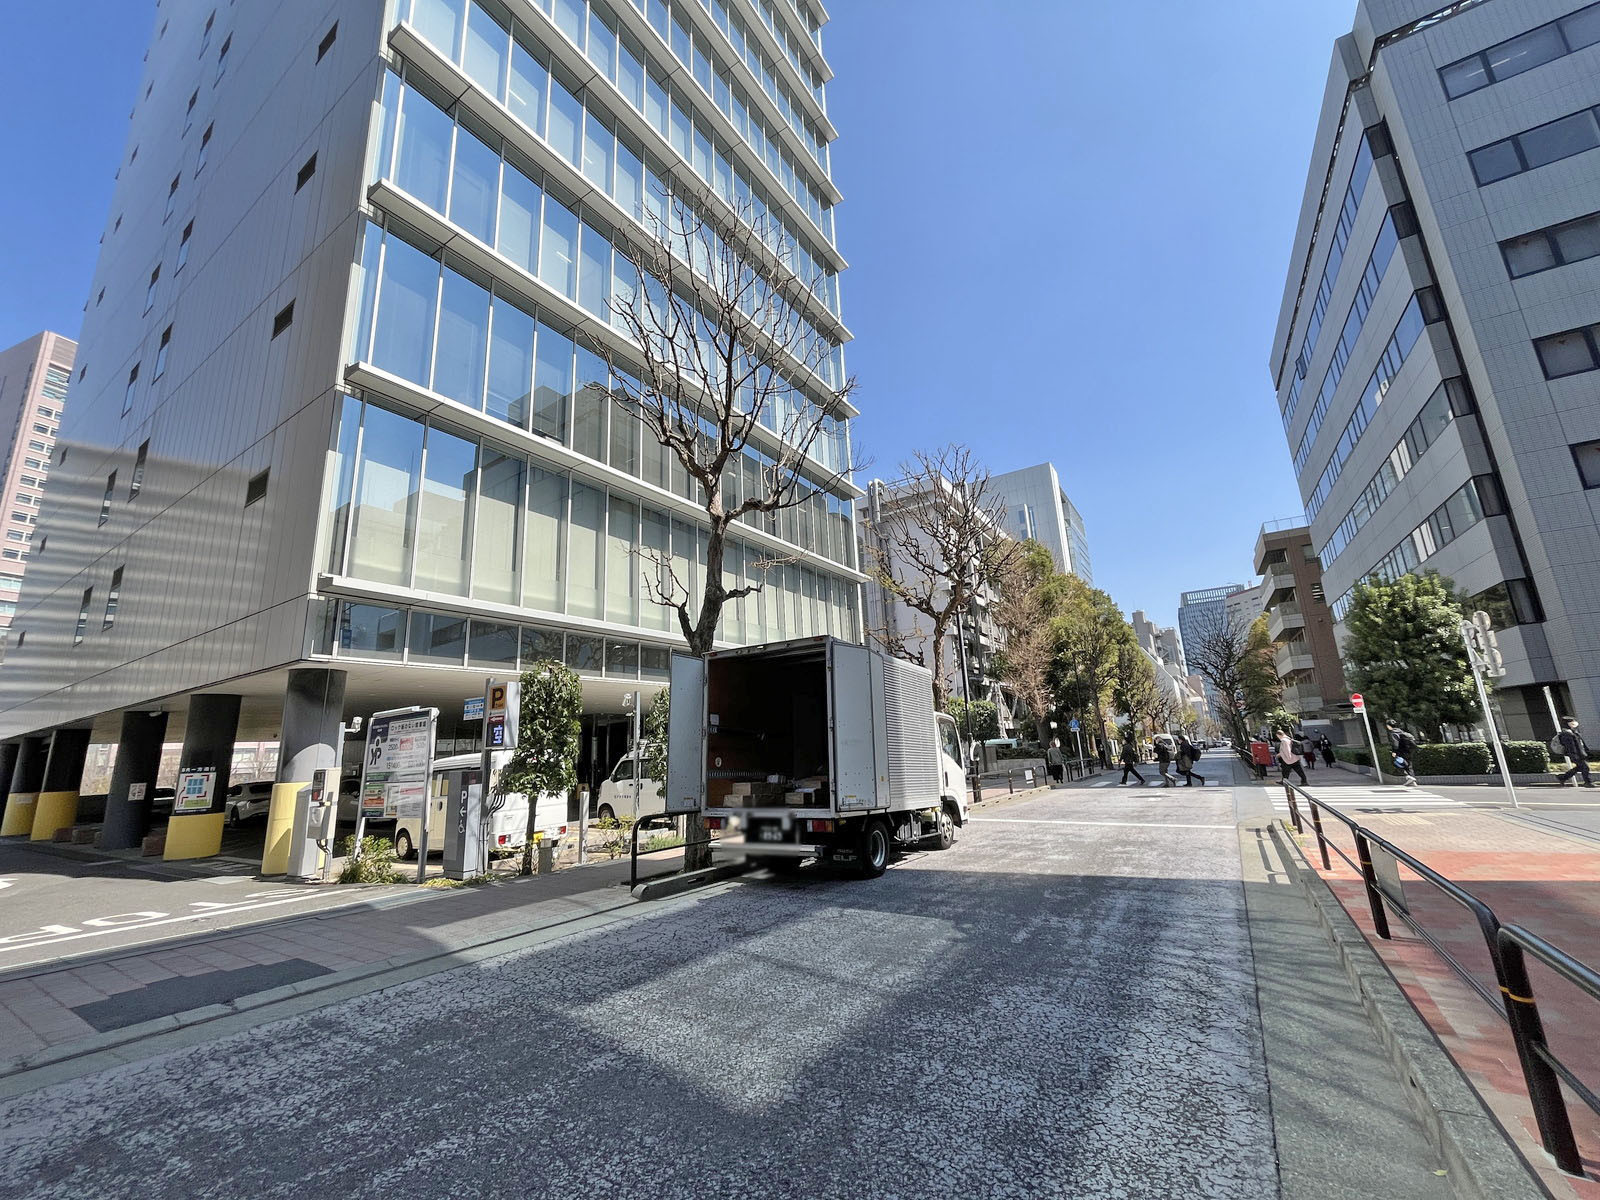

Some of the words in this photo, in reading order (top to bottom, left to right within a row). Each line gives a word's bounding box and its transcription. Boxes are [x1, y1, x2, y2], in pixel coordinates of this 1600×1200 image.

[492, 687, 504, 709] P
[493, 724, 503, 744] 空
[461, 790, 468, 804] P
